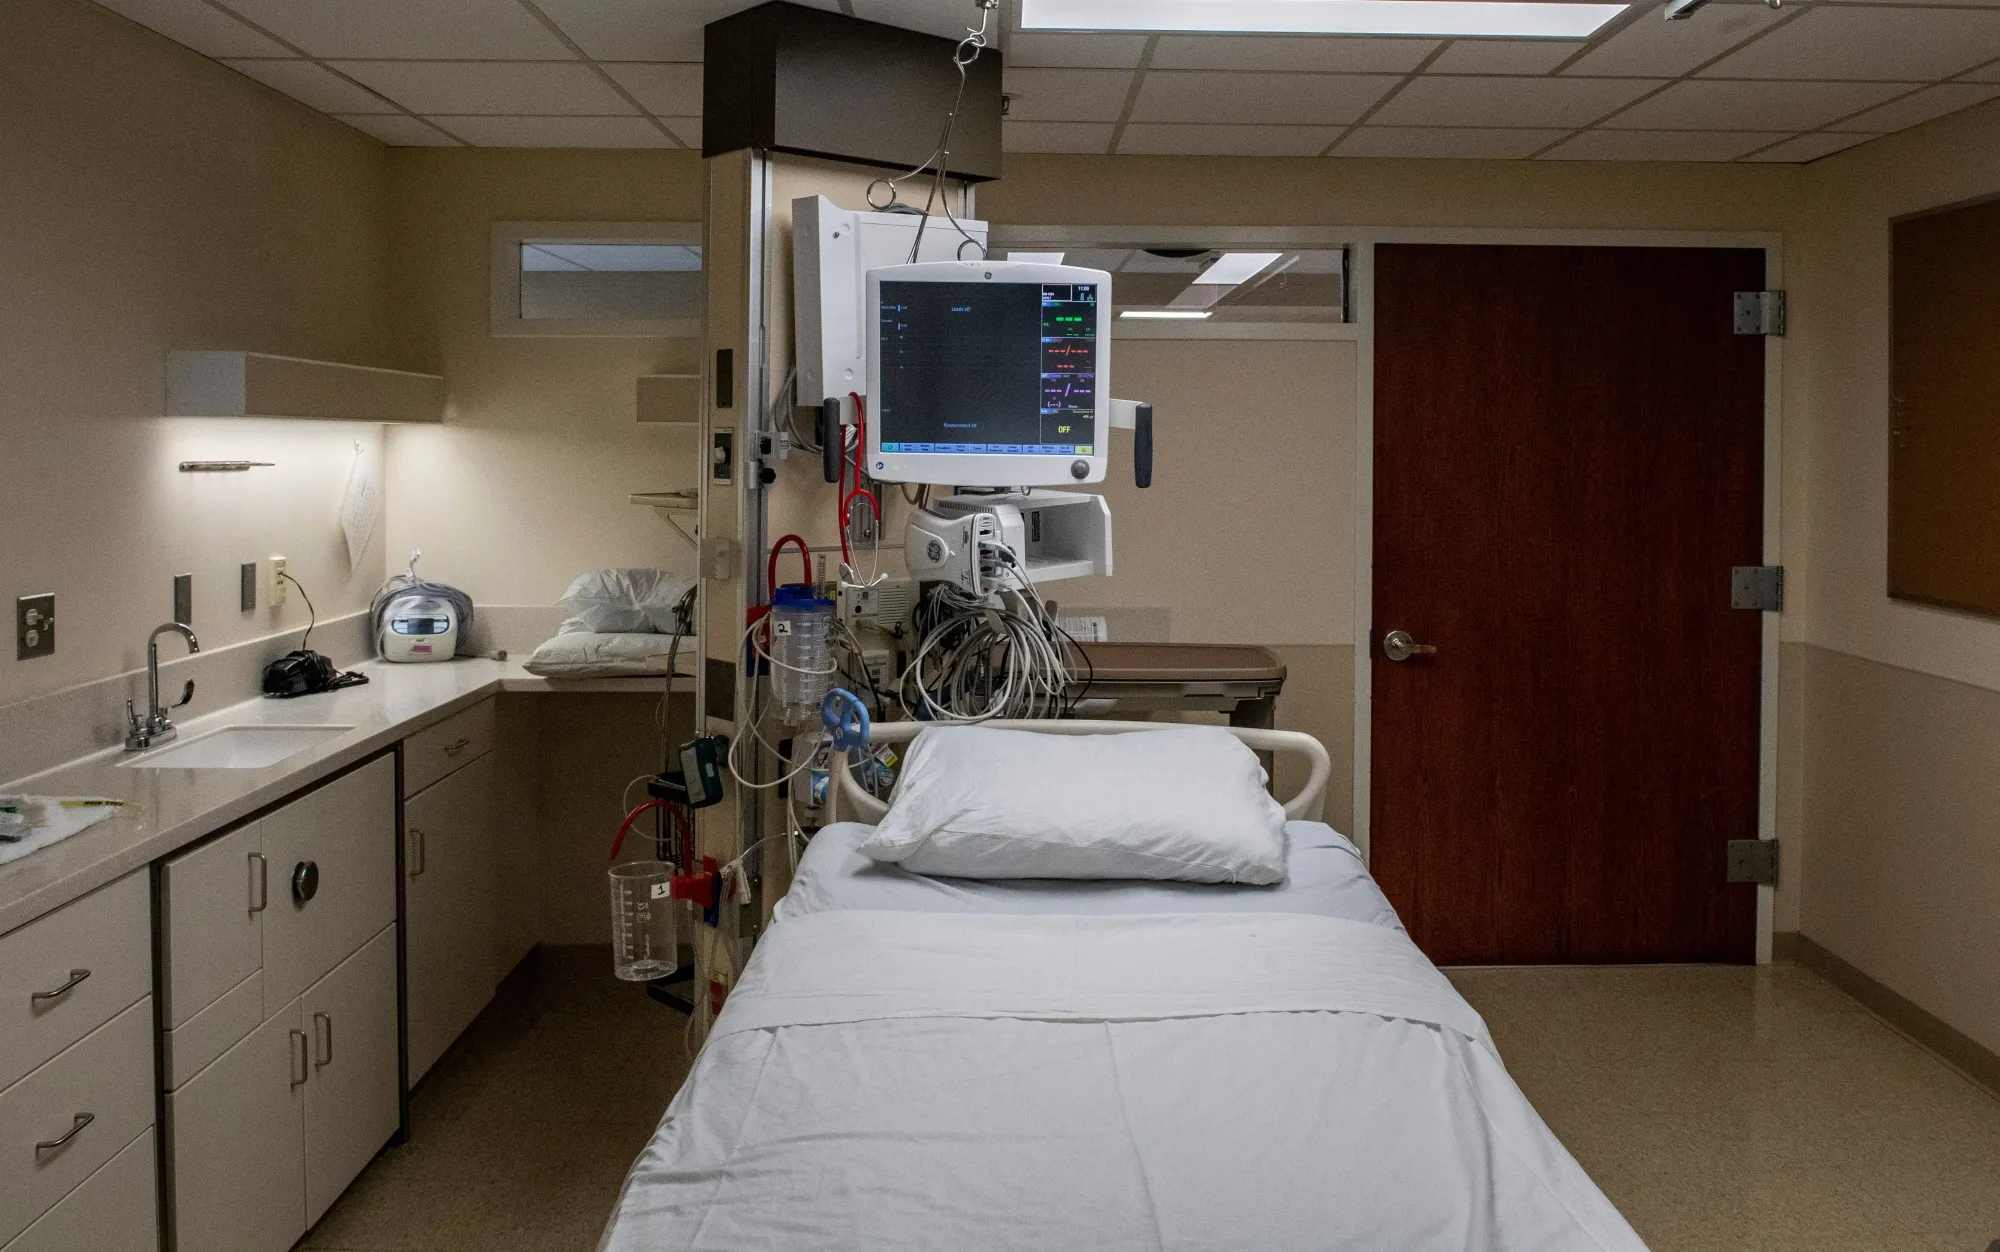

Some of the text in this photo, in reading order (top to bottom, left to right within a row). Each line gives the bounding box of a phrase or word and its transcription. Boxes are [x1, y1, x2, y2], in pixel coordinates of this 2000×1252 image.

[1058, 425, 1071, 433] OFF
[778, 623, 789, 633] 2
[657, 885, 666, 896] 1
